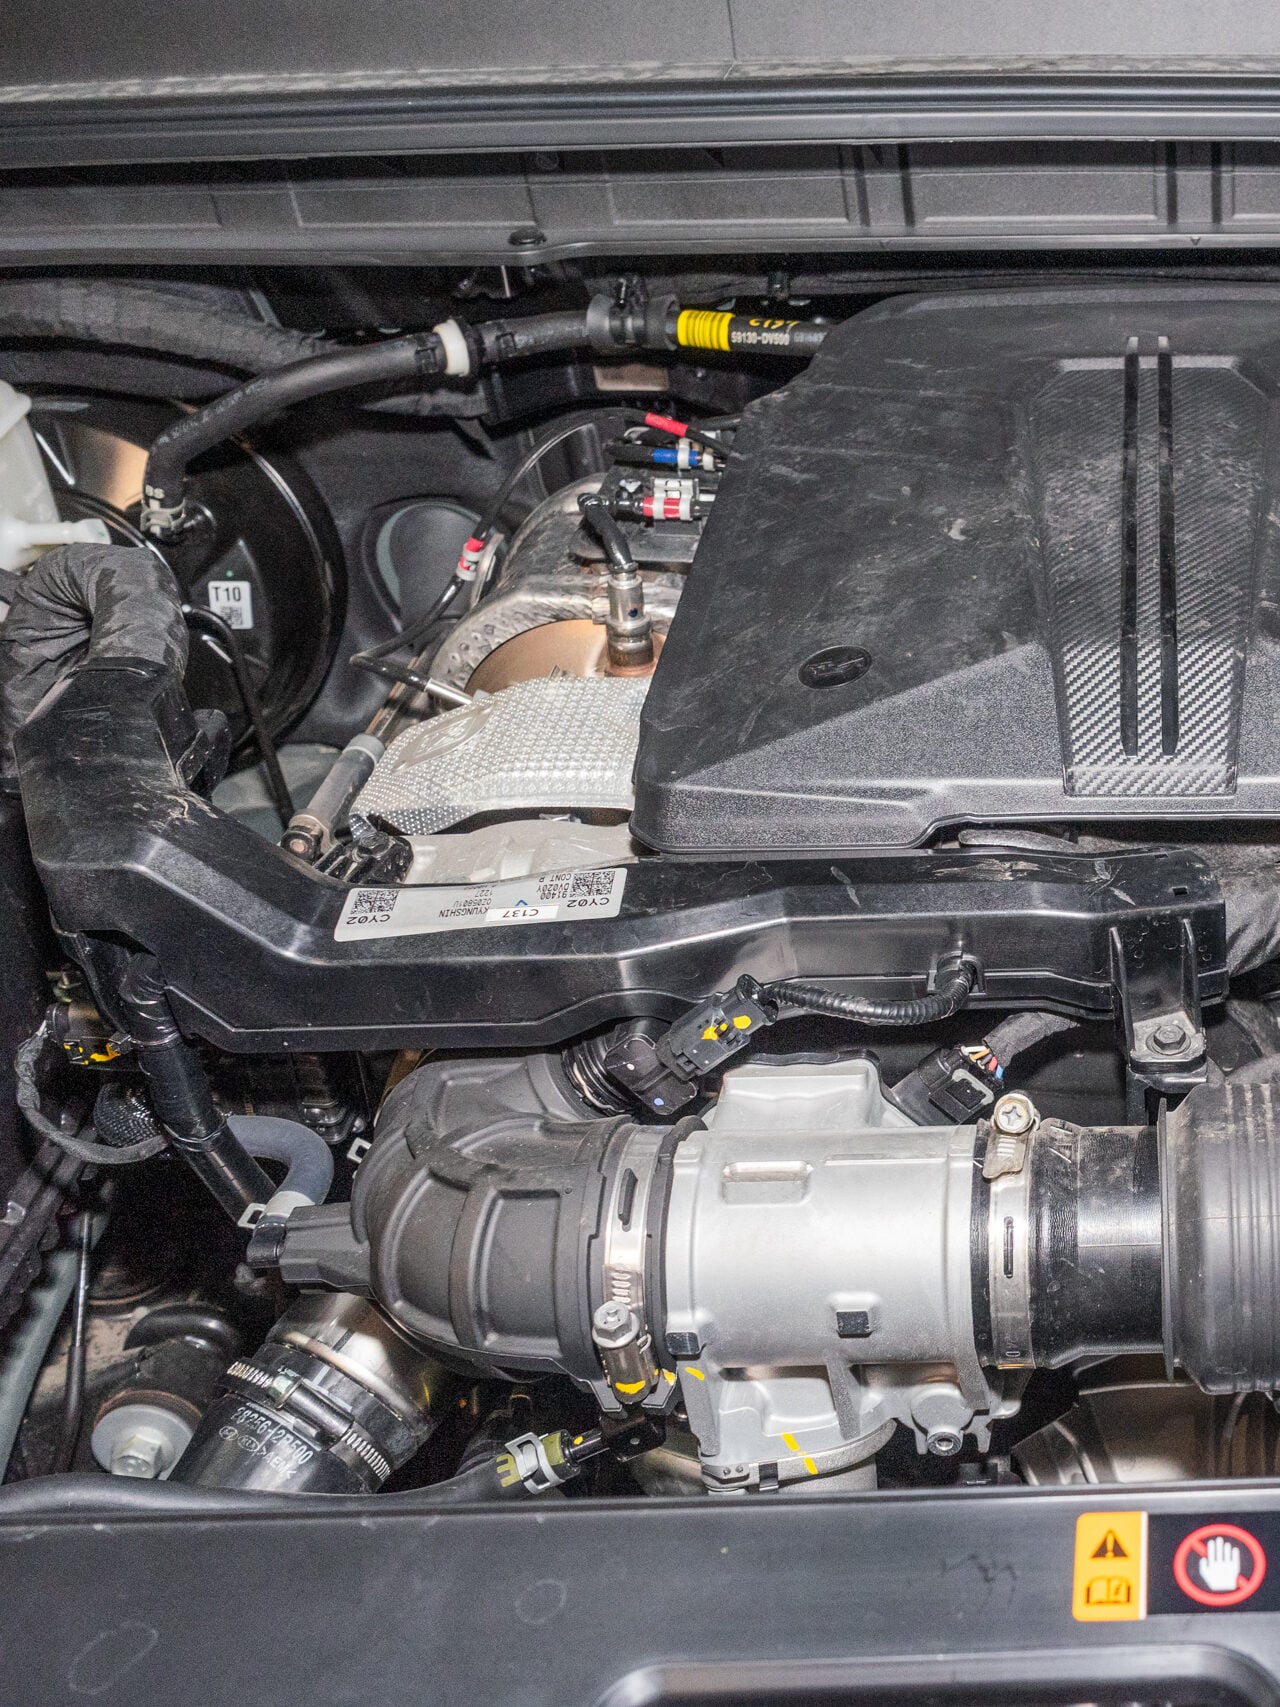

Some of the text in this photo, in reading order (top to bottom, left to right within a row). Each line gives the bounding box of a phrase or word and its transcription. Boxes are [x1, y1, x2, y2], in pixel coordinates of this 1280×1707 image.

[212, 586, 241, 602] T10
[567, 897, 610, 908] CY02
[439, 906, 490, 918] KYUNGSHIN
[502, 907, 539, 919] C137
[346, 914, 391, 925] CY02
